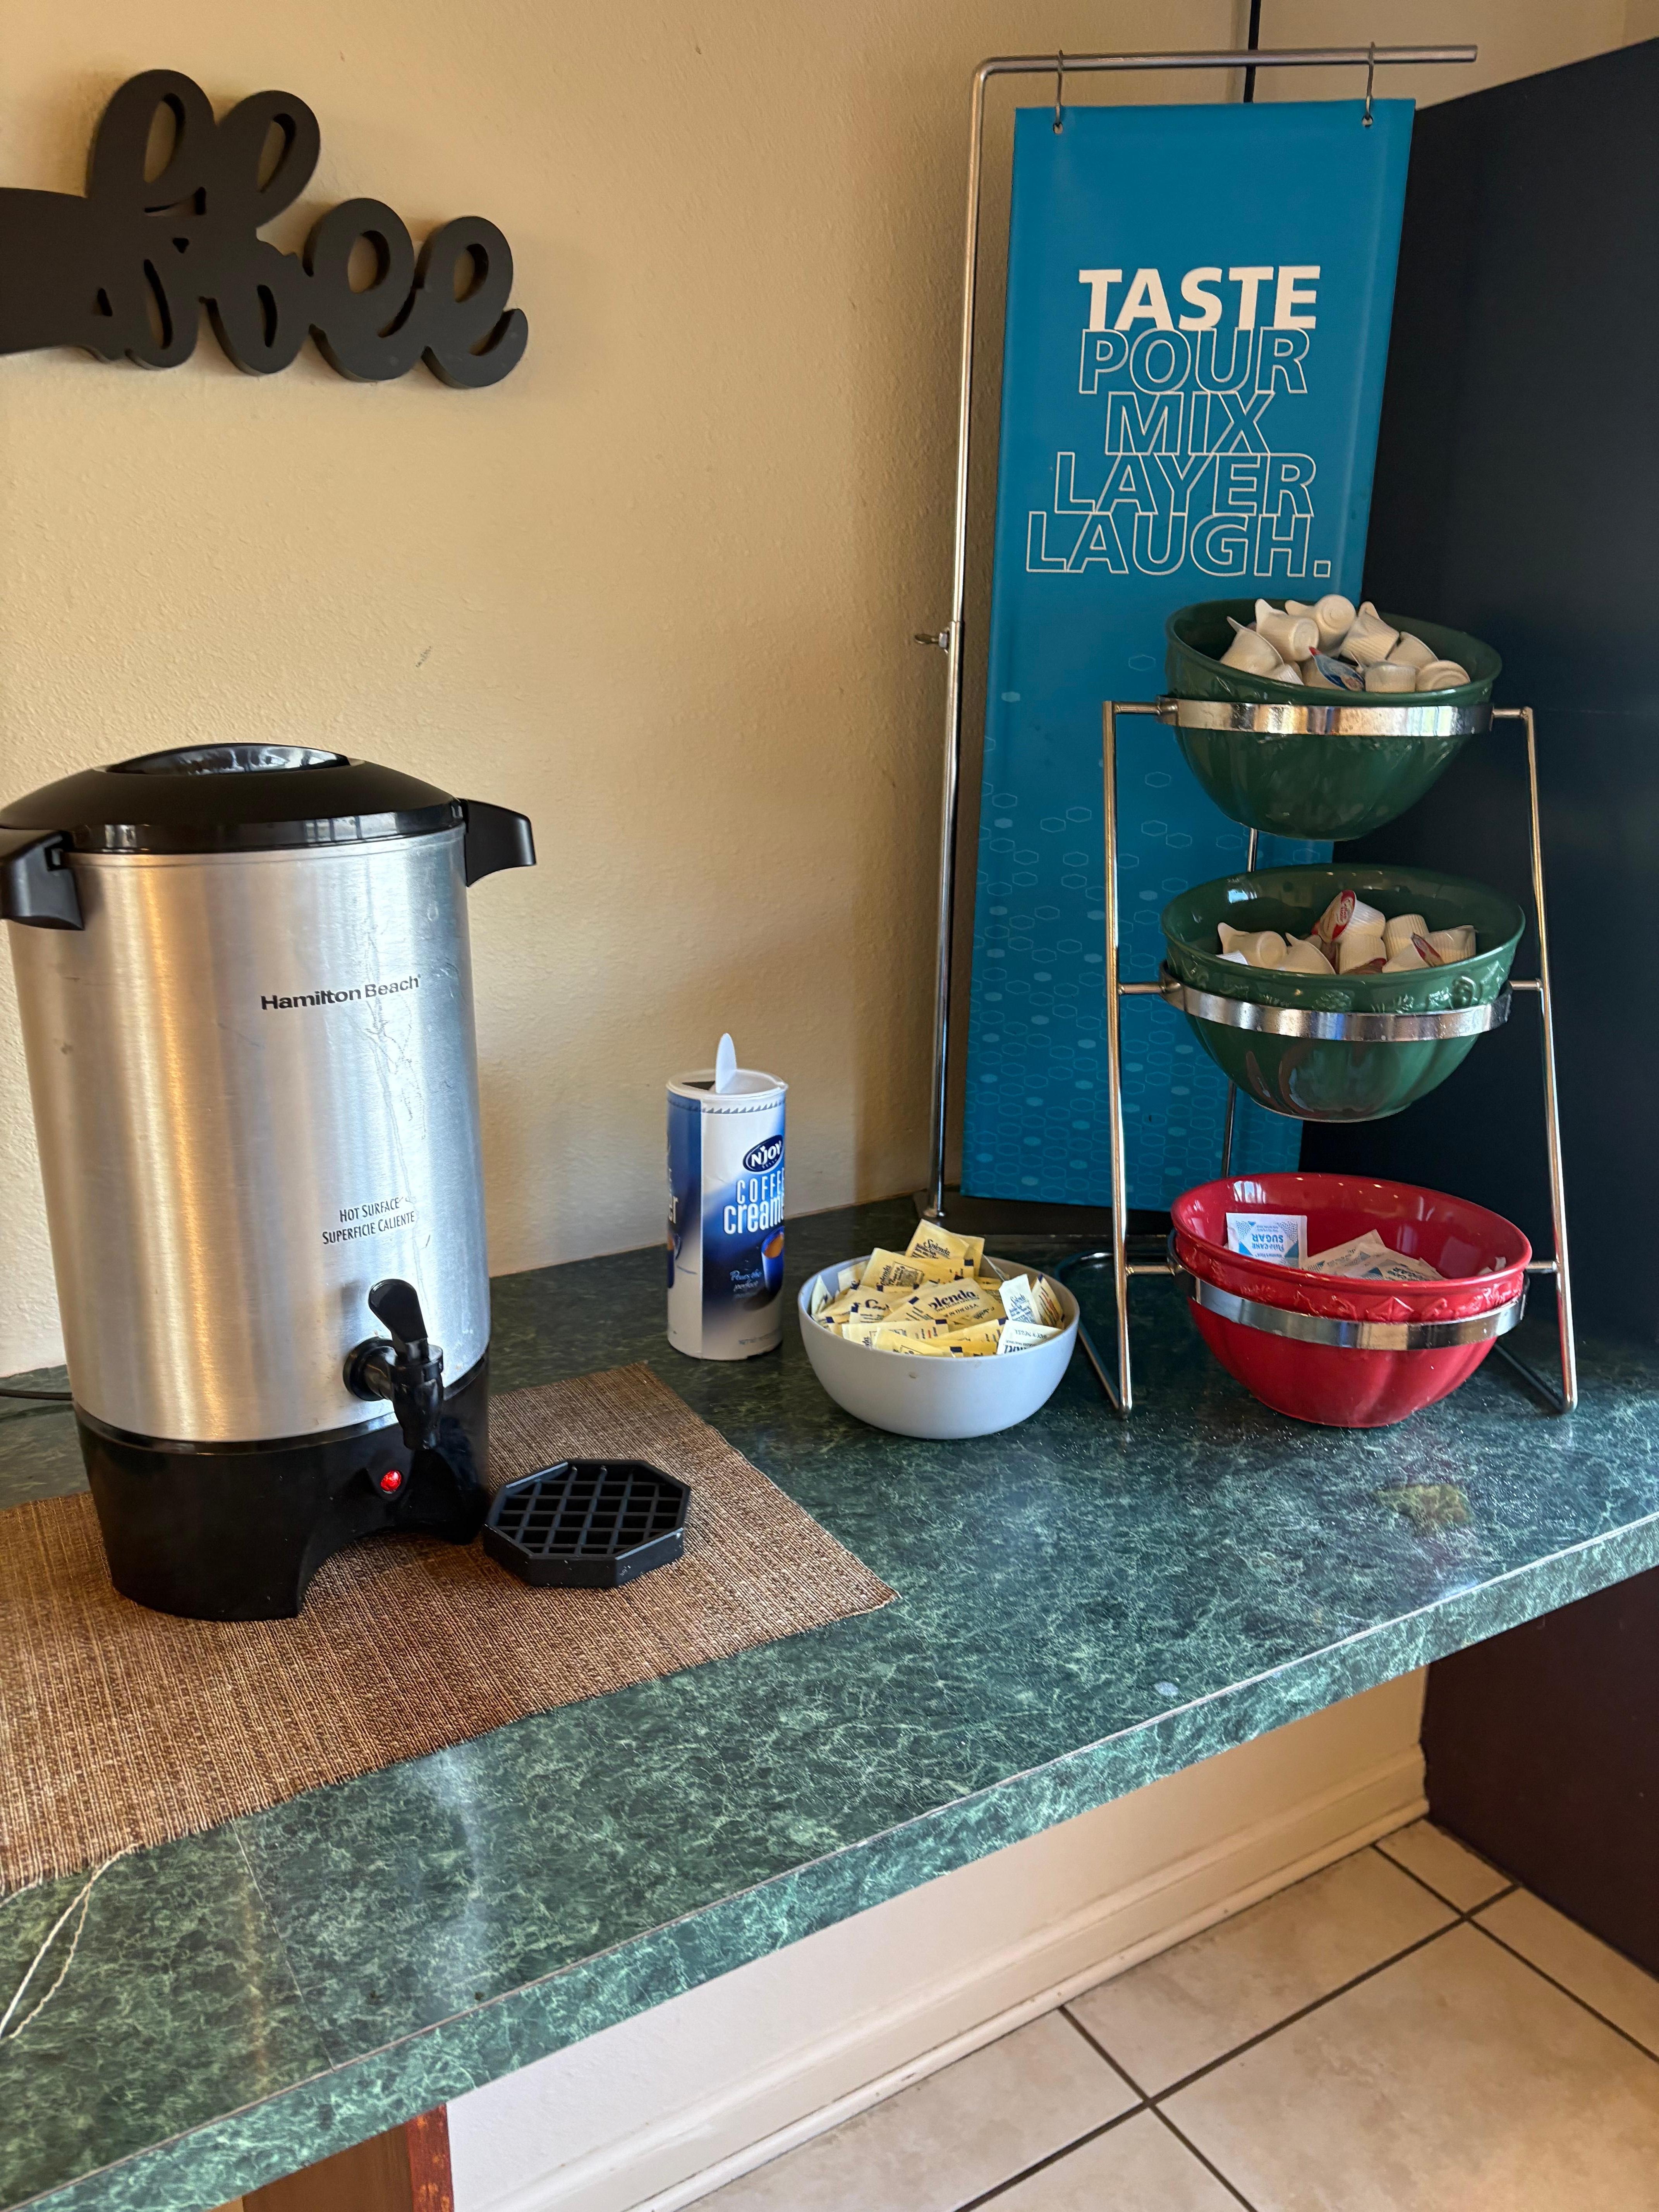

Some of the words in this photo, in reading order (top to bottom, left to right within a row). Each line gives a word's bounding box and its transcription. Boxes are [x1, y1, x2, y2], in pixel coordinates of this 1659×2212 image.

[0, 70, 529, 388] ffee
[1079, 266, 1321, 331] TASTE
[1079, 327, 1310, 394] POUR
[1105, 391, 1274, 456] MIX
[1054, 452, 1316, 518] LAYER
[1027, 512, 1331, 577] LAUGH.
[260, 989, 362, 1010] Hamilton
[365, 975, 419, 998] Beach
[322, 1222, 376, 1245] SUPERFICIE
[378, 1211, 415, 1232] CALIENTE
[340, 1207, 359, 1223] HOT
[362, 1197, 400, 1218] SURFACE
[923, 1239, 950, 1256] Splenda
[1252, 1234, 1284, 1243] SUGAR
[928, 1290, 977, 1309] plenda
